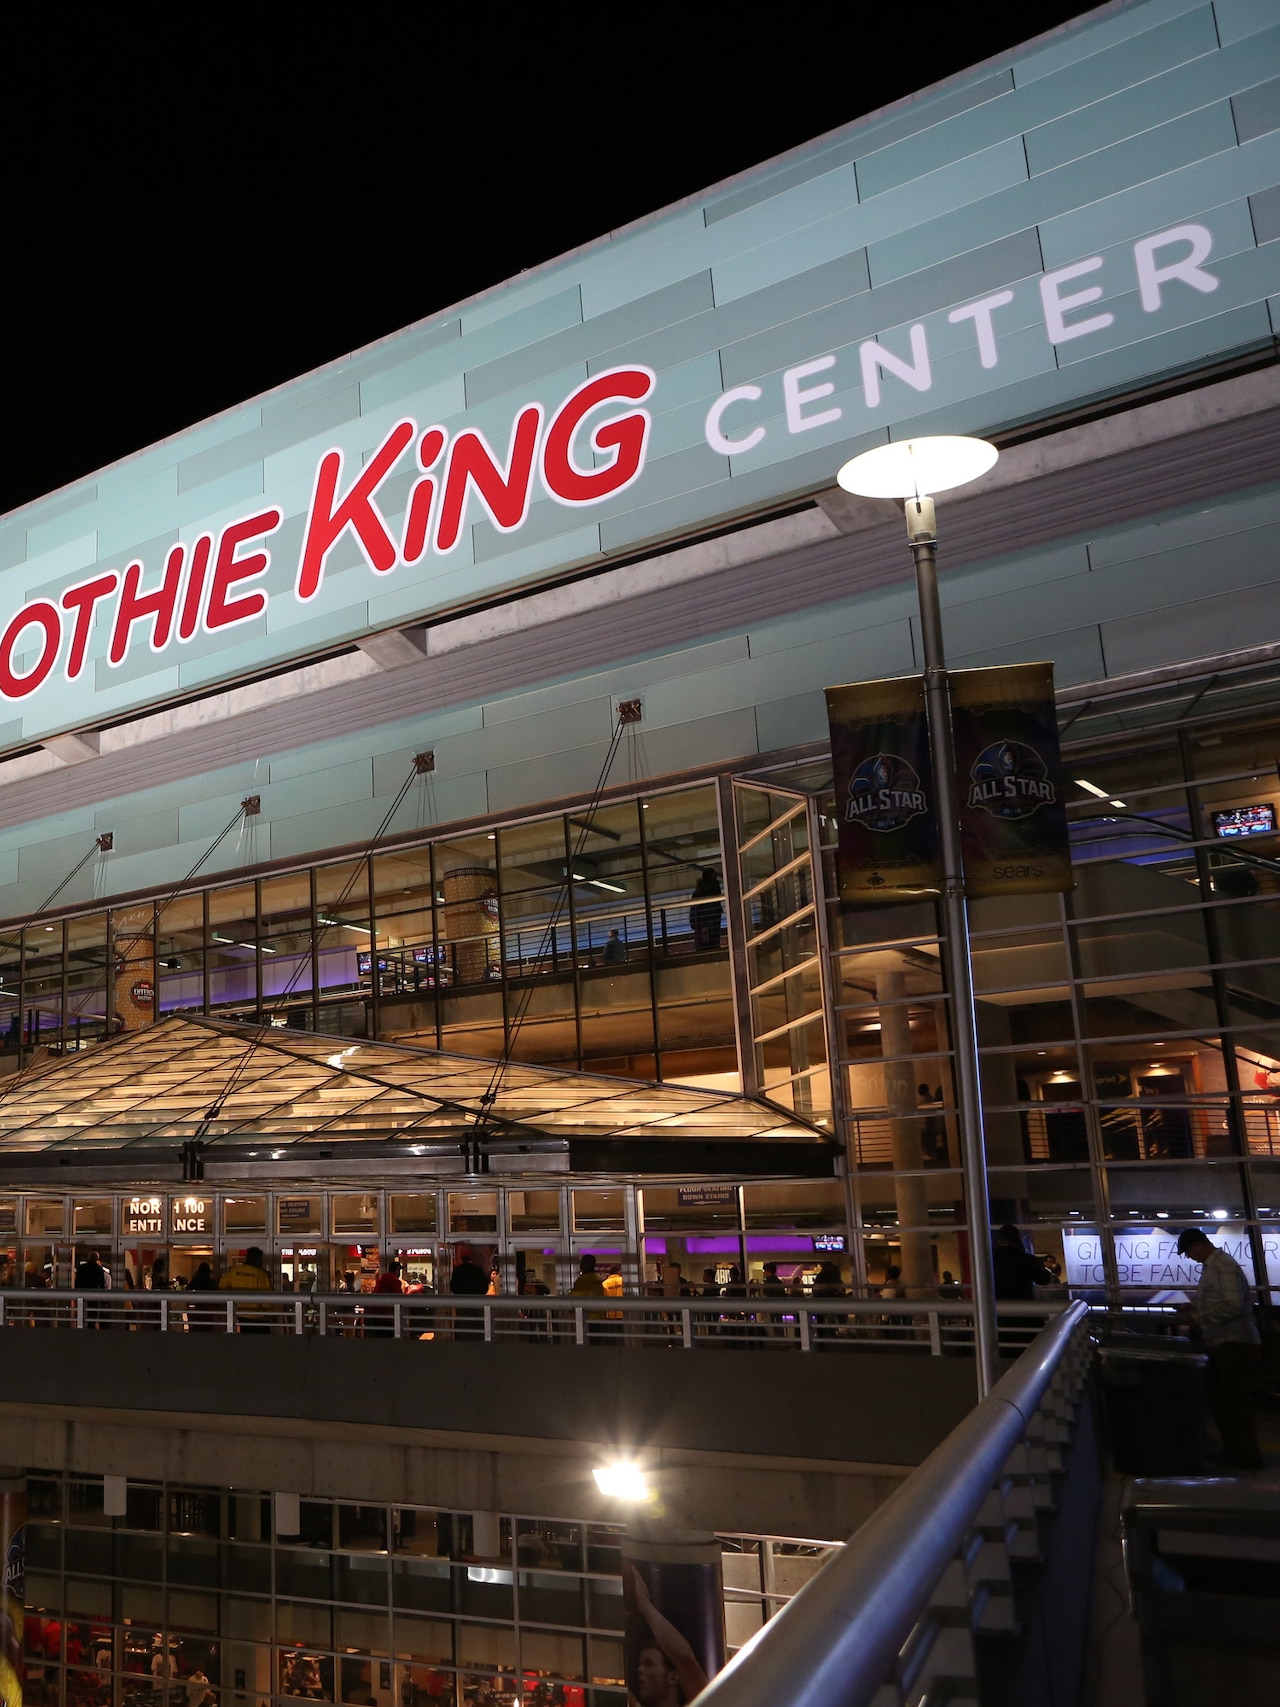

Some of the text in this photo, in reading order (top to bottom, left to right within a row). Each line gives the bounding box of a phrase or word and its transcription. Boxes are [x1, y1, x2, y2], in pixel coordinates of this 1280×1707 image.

[705, 224, 1219, 456] CENTER
[970, 775, 1052, 805] ALL STAR
[848, 788, 924, 819] ALL STAR
[992, 863, 1045, 880] sears
[184, 1201, 205, 1214] 100
[705, 1192, 730, 1200] STAIRS
